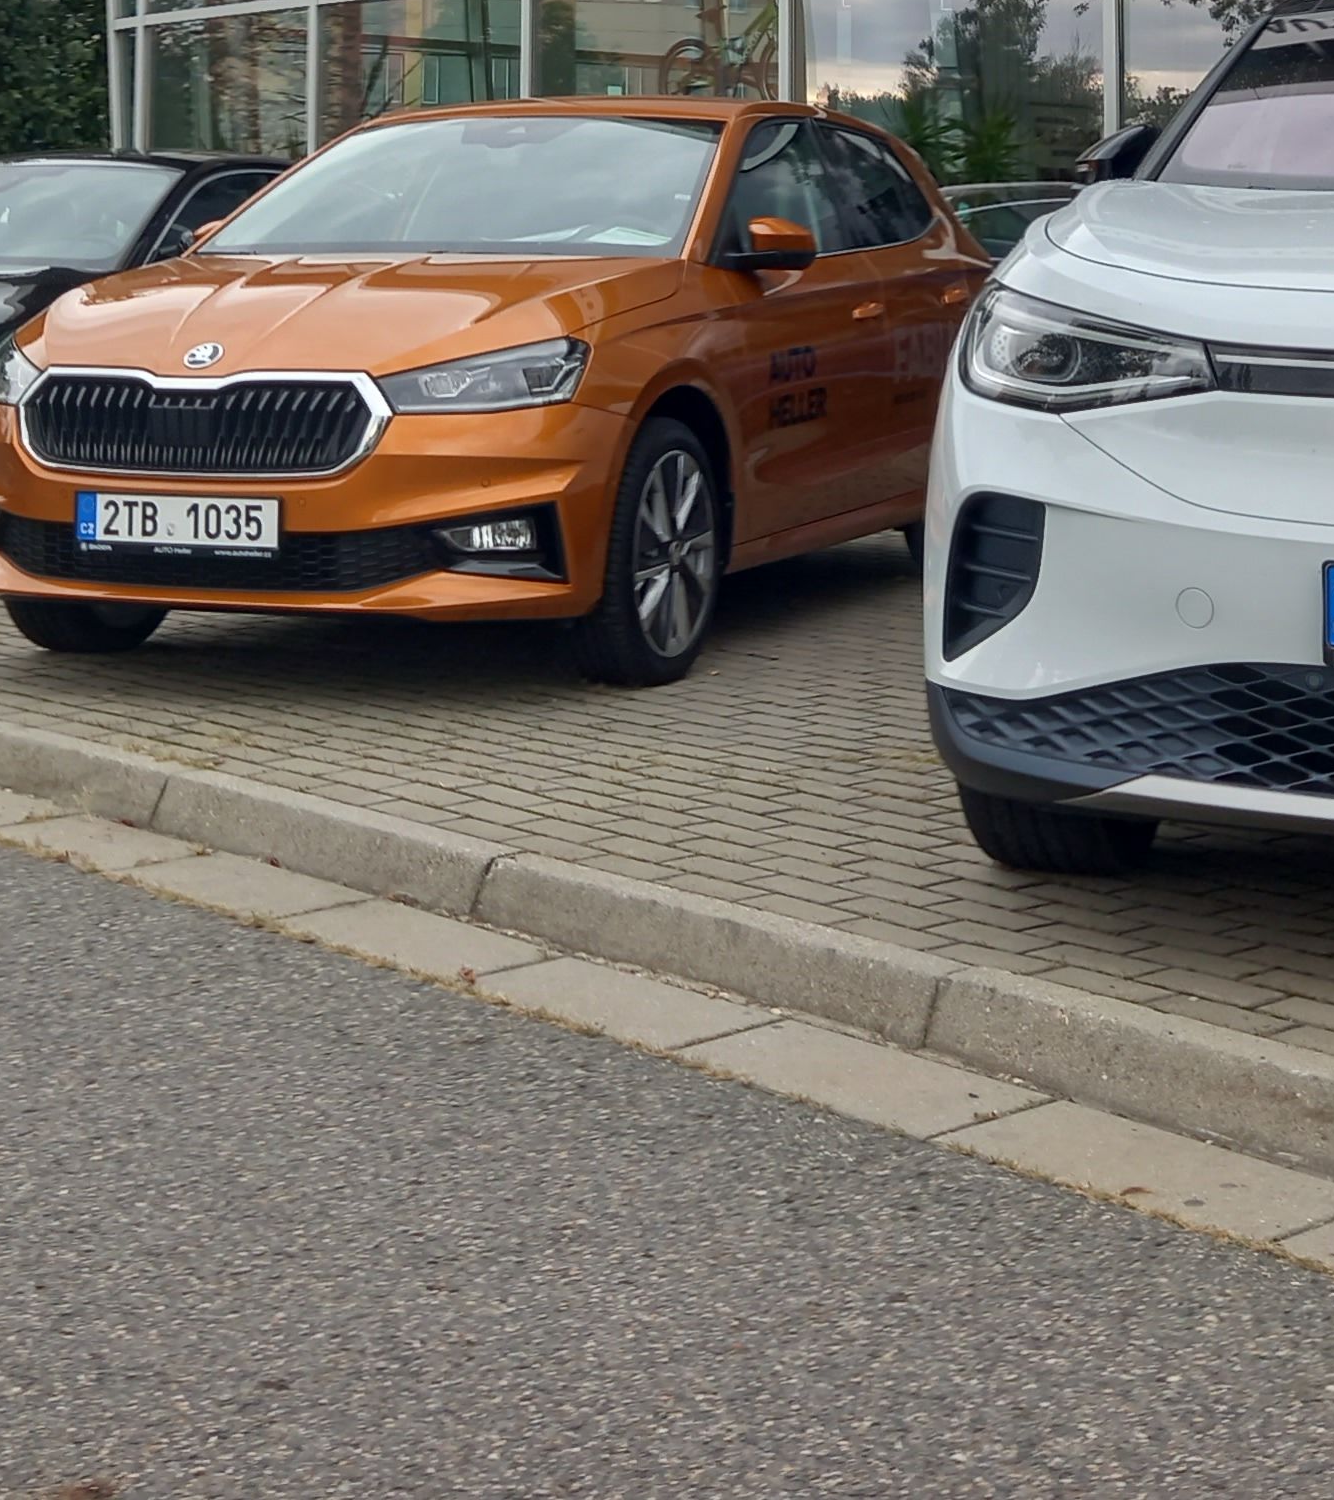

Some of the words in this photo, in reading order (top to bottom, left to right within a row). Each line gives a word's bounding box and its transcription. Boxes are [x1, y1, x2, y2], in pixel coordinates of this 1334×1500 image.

[770, 346, 816, 382] AUTO
[770, 387, 827, 429] HELLER
[80, 522, 95, 535] CZ
[103, 500, 158, 537] 2TB
[187, 503, 263, 541] 1035
